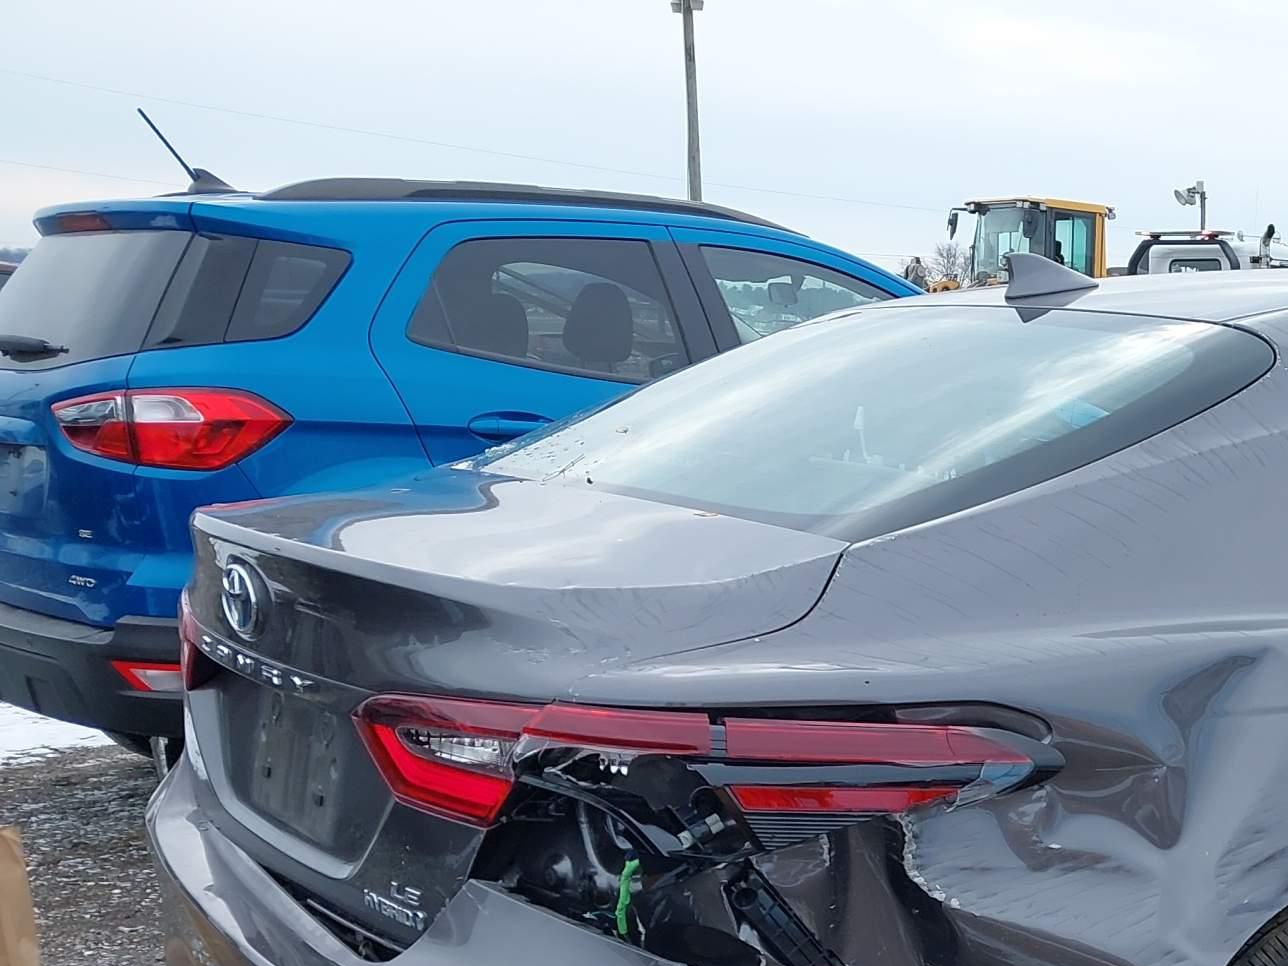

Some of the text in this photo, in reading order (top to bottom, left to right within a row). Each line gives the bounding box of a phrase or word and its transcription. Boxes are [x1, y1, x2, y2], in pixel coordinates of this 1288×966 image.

[201, 635, 315, 693] CAMRY
[363, 889, 428, 930] HYBRID
[390, 881, 421, 905] LE
